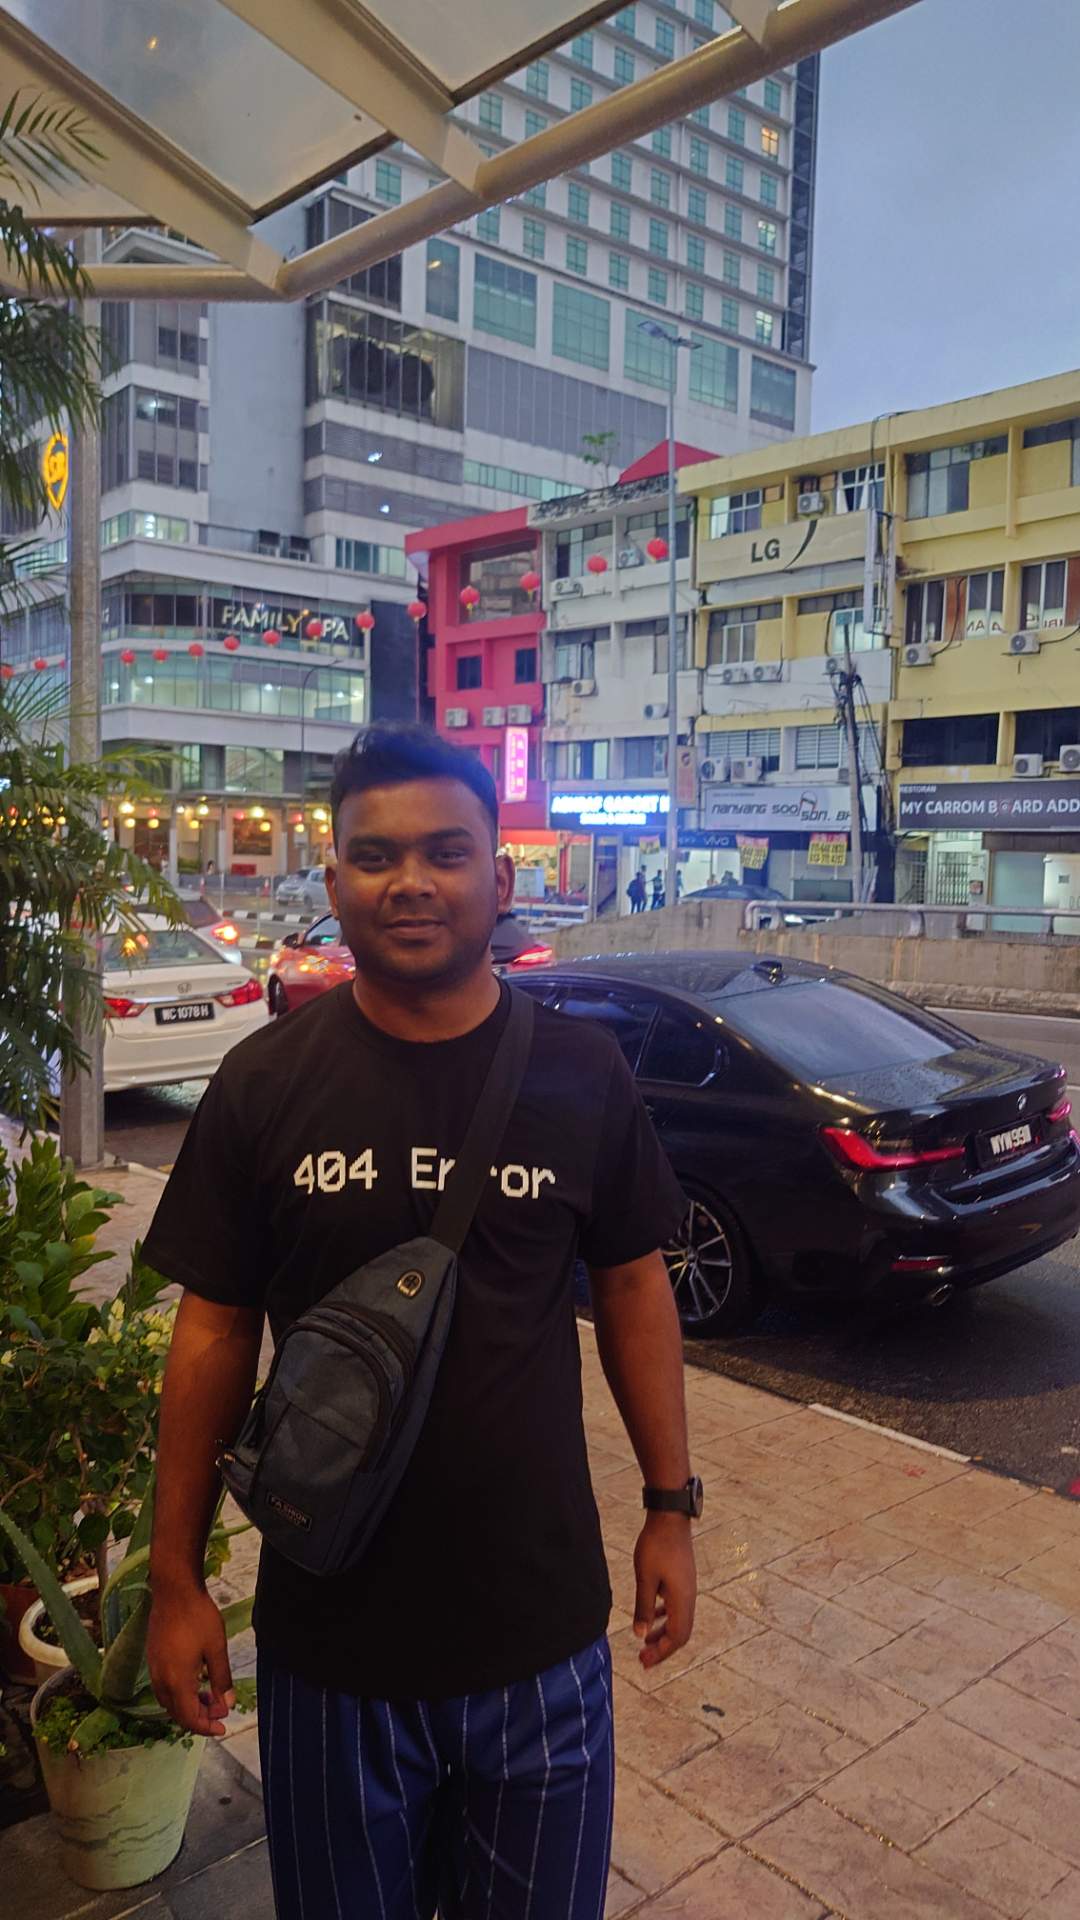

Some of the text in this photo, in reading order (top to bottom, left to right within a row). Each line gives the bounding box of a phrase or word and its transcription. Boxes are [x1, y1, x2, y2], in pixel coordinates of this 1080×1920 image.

[751, 537, 780, 563] LG
[221, 604, 306, 634] FAMILY
[901, 801, 923, 815] MY
[925, 799, 985, 815] CARROM
[293, 1146, 556, 1200] 404 Eror
